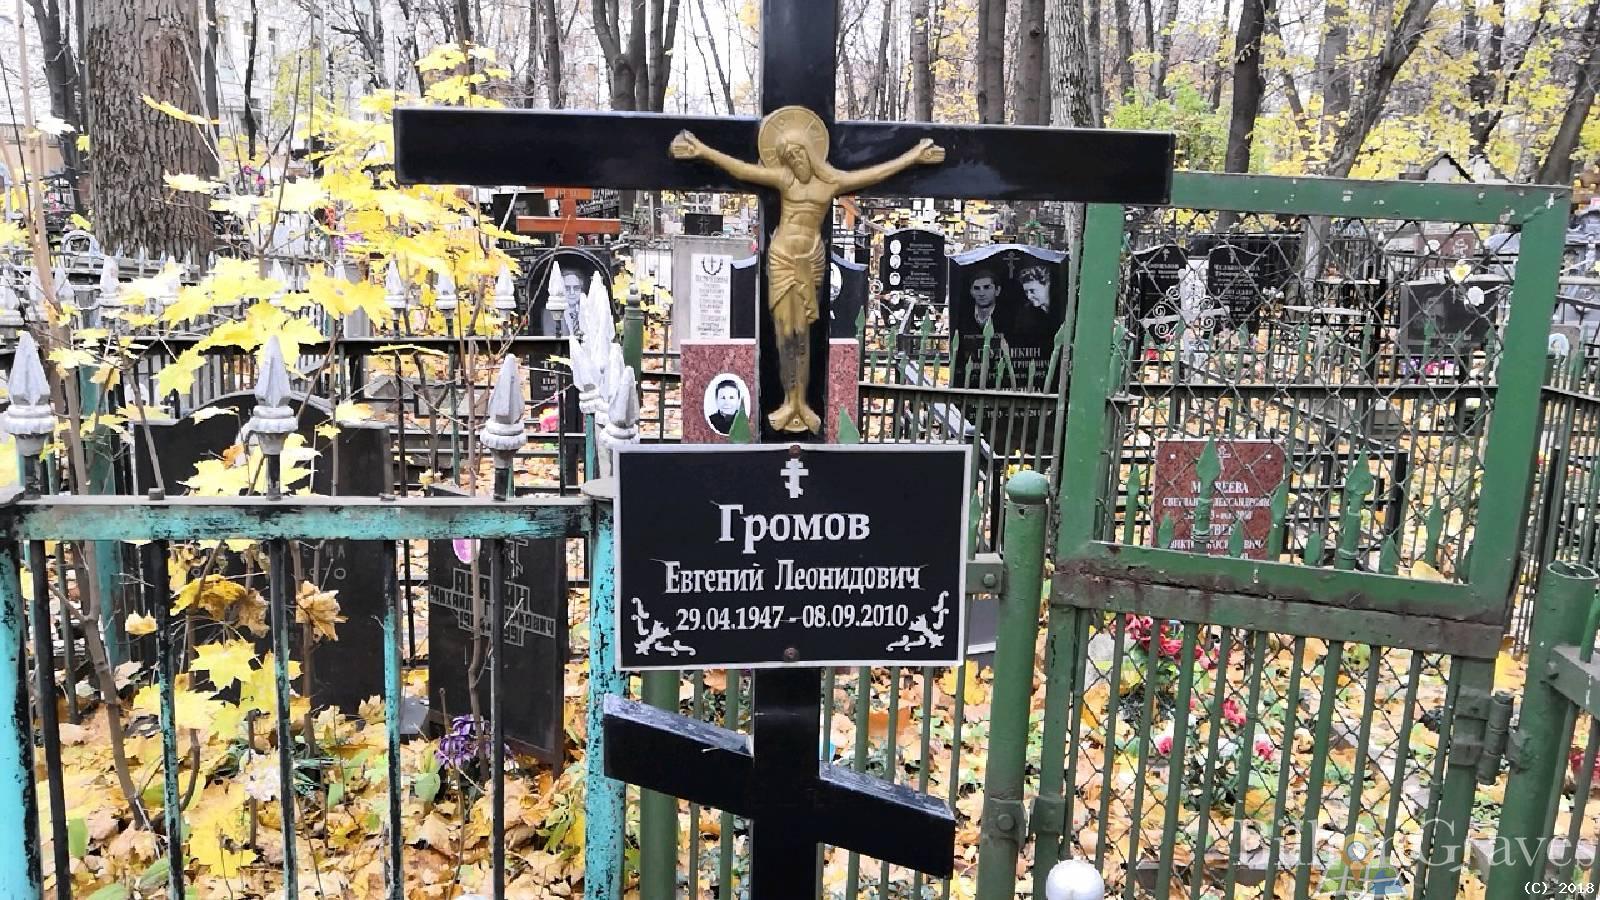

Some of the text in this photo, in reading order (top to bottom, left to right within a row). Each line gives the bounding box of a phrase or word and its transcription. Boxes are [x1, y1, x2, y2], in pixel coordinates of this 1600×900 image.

[718, 503, 871, 554] Громов
[664, 559, 922, 594] Евгений Леонидович
[675, 605, 785, 630] 29.04.1947
[802, 603, 909, 628] 08.09.2010
